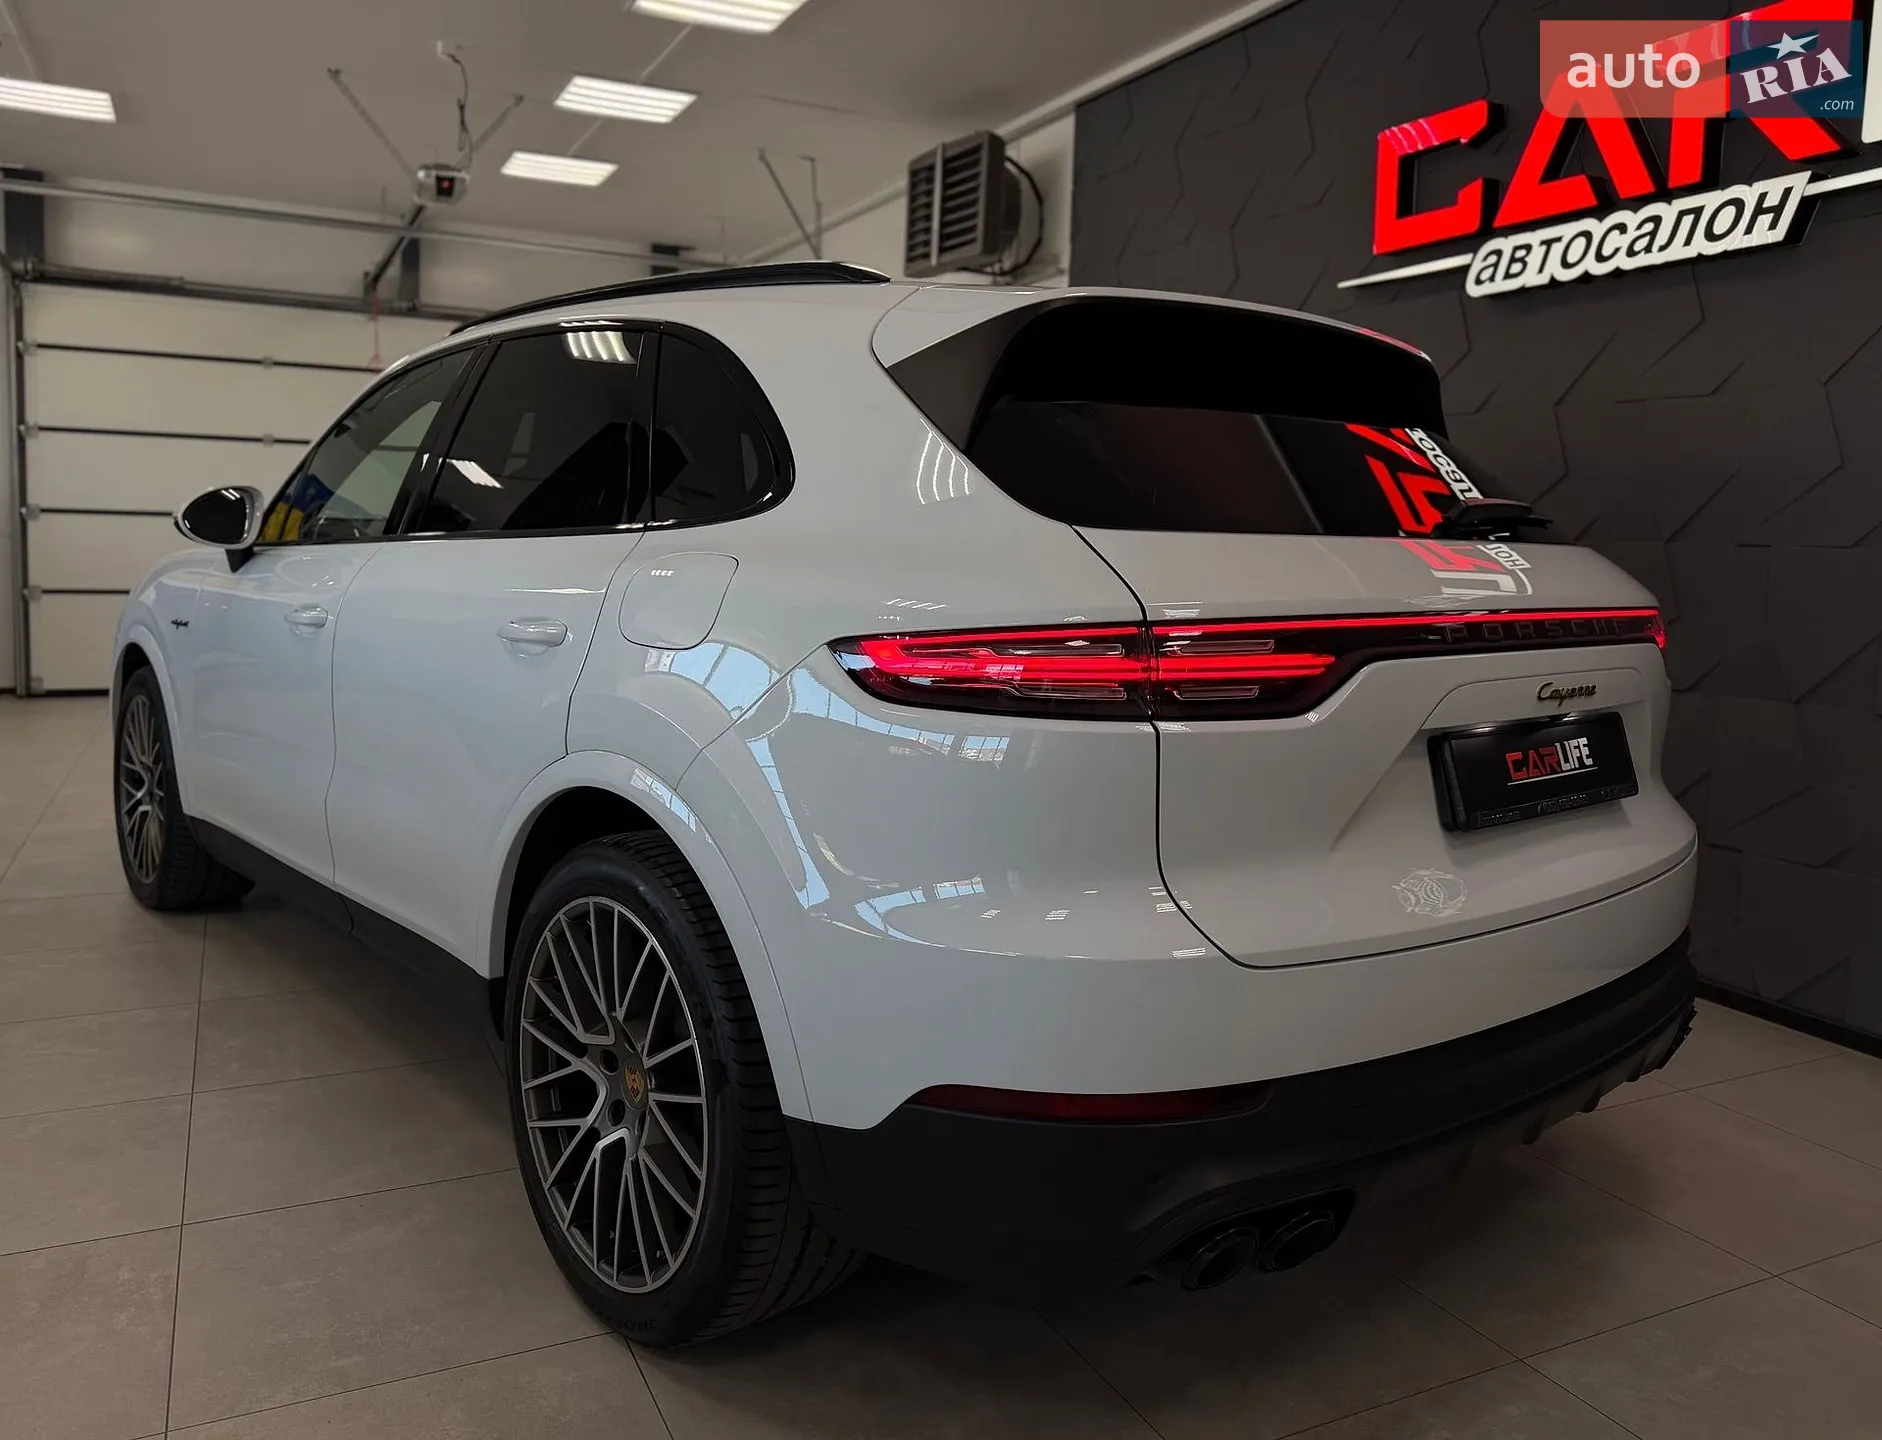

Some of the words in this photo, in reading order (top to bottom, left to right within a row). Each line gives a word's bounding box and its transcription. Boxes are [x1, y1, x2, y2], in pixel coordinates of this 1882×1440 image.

[1373, 0, 1882, 255] CAR
[1474, 184, 1795, 288] автосалон
[1445, 618, 1626, 644] PORSCHE
[1536, 682, 1597, 708] Cayenne
[1505, 737, 1594, 782] CARLIFE
